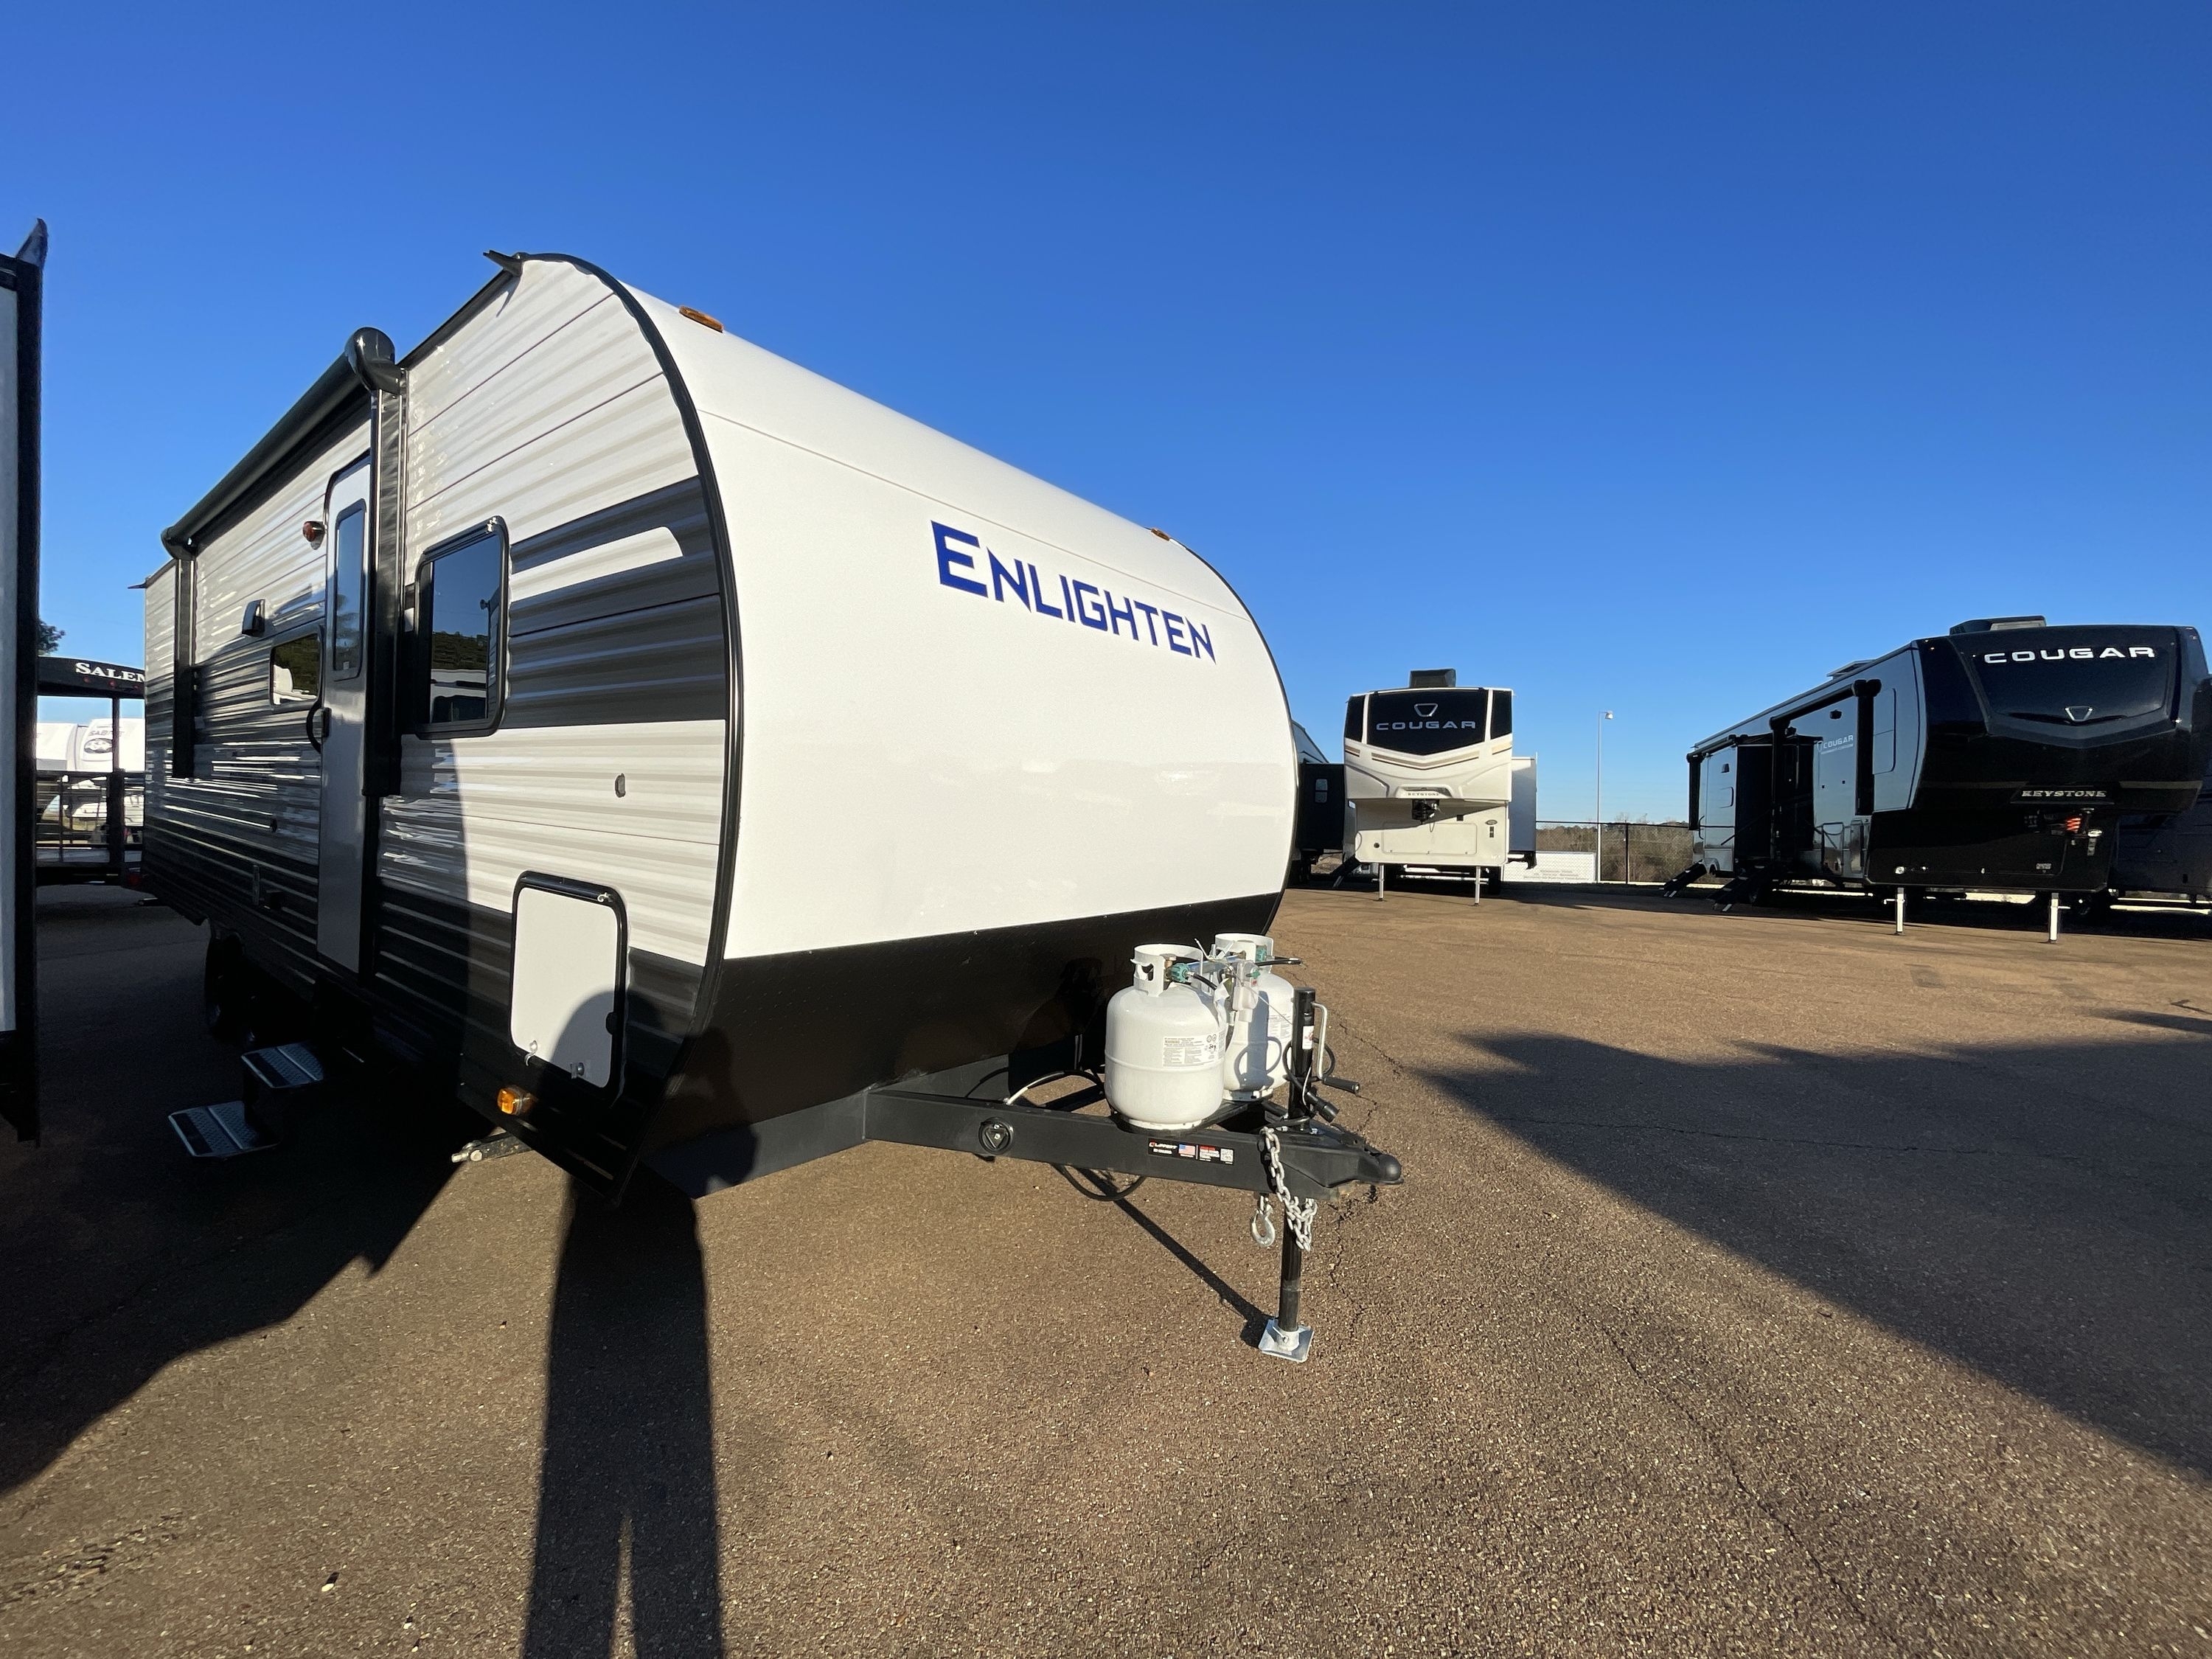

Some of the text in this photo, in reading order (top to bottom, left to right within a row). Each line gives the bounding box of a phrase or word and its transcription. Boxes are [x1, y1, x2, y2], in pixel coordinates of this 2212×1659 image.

[931, 520, 1217, 665] ENLIGHTEN
[1984, 647, 2155, 664] COUGAR
[1376, 720, 1476, 731] COUGAR
[1823, 734, 1854, 749] COUGAR
